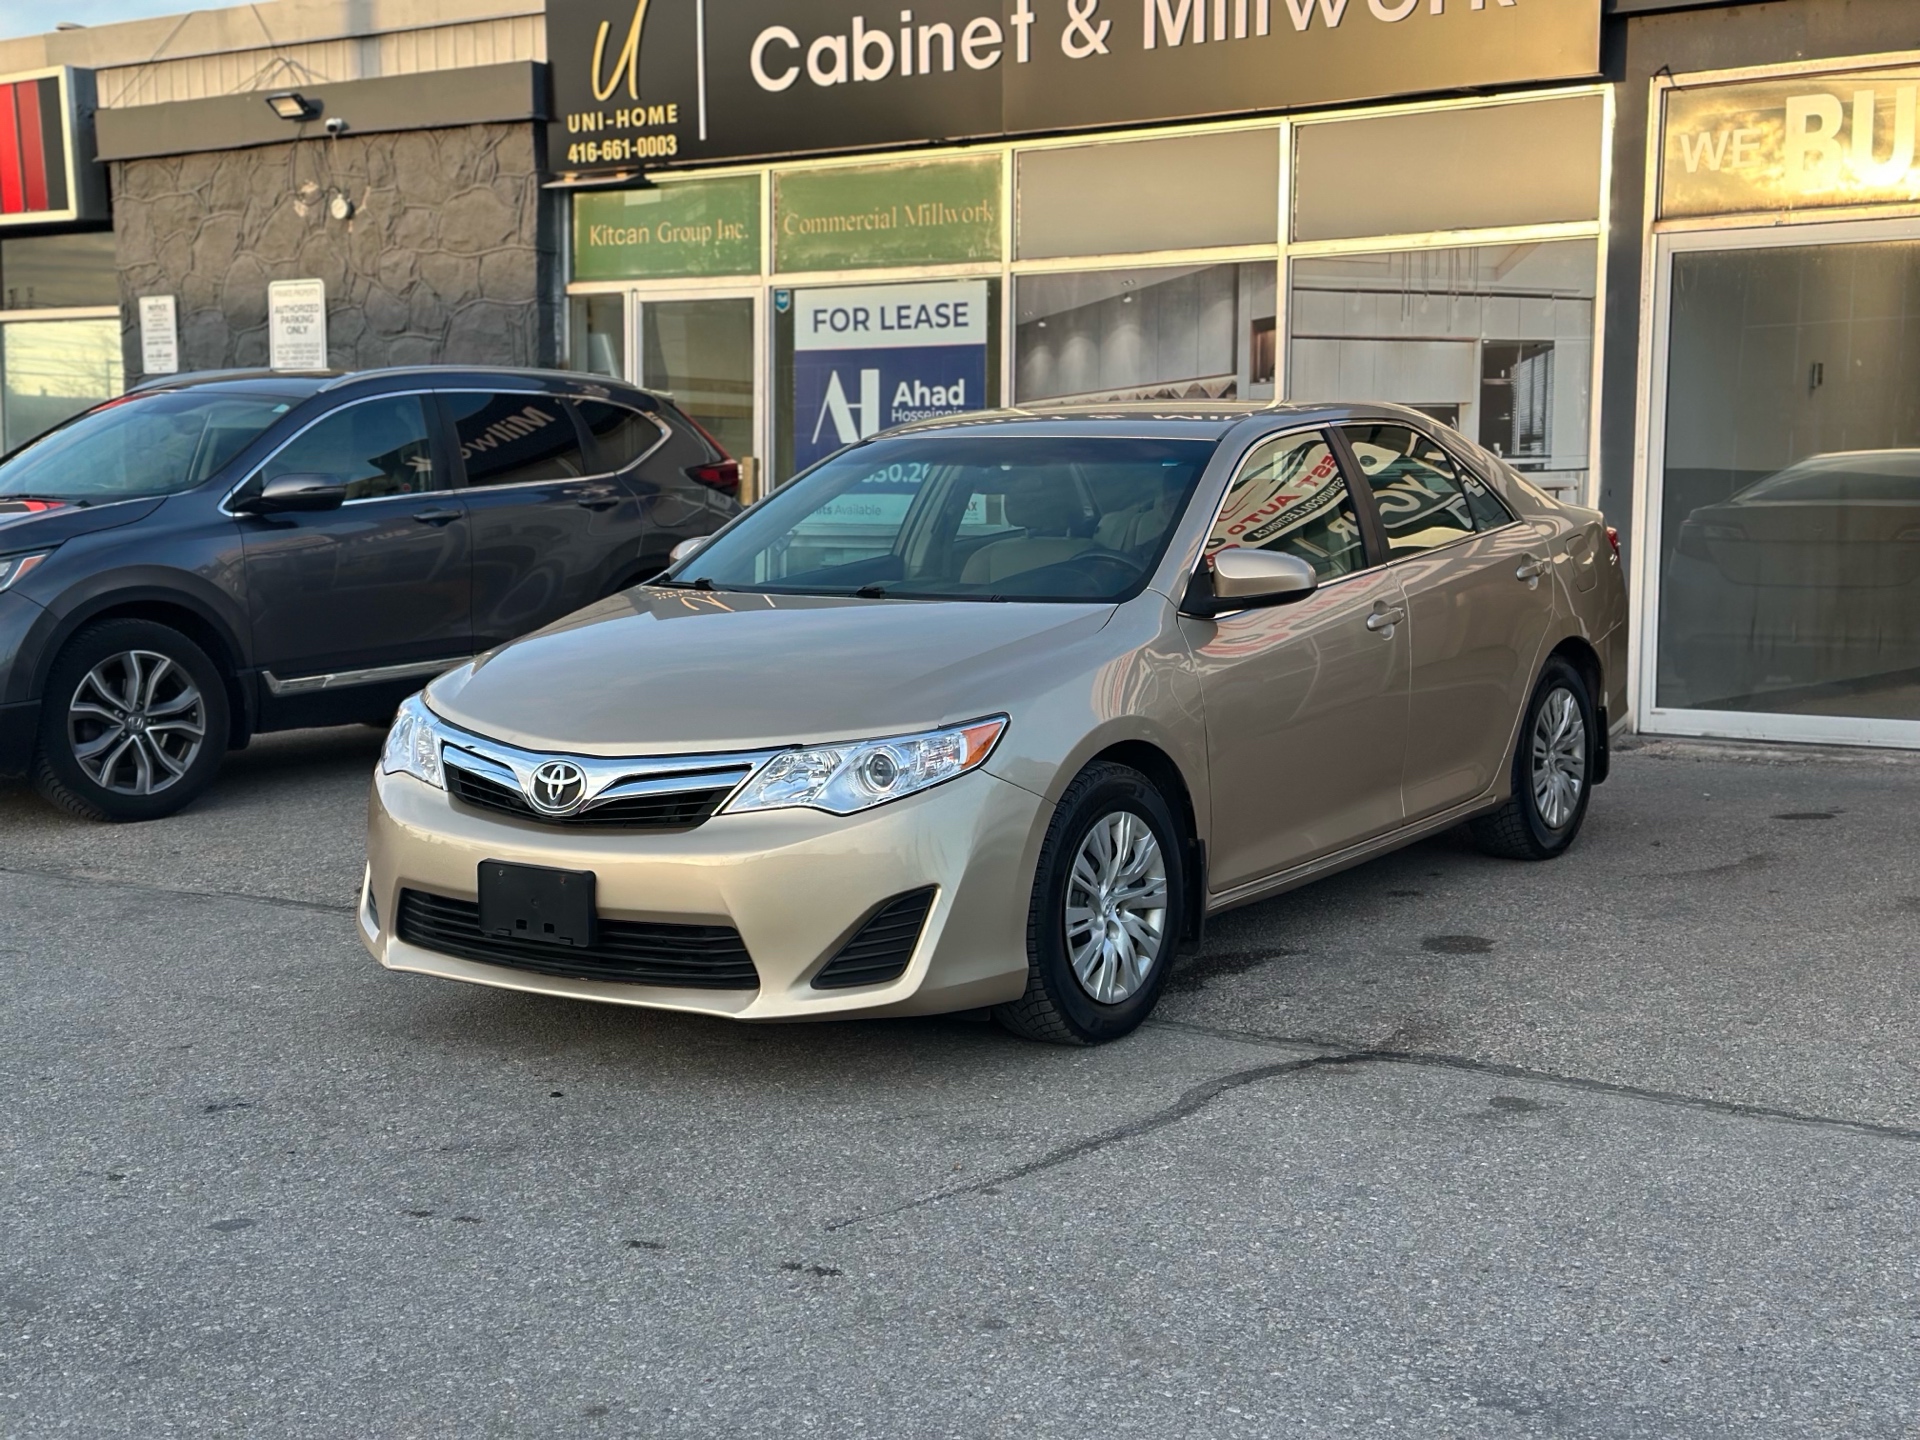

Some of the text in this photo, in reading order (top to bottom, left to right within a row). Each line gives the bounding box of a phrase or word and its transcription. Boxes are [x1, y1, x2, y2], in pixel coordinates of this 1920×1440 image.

[750, 0, 1517, 92] Cabinet & Millw
[567, 104, 678, 133] UNI-HOME
[567, 134, 678, 164] 416-661-0003
[1680, 86, 1918, 195] WE BU
[783, 199, 994, 235] Commercial Millwork
[590, 219, 749, 247] Kitcan Group Inc.
[275, 303, 319, 315] AUTHORIZED
[280, 314, 314, 325] PARKING
[812, 302, 969, 334] FOR LEASE
[286, 325, 309, 335] ONLY
[892, 378, 965, 407] Ahad
[834, 504, 882, 516] Available
